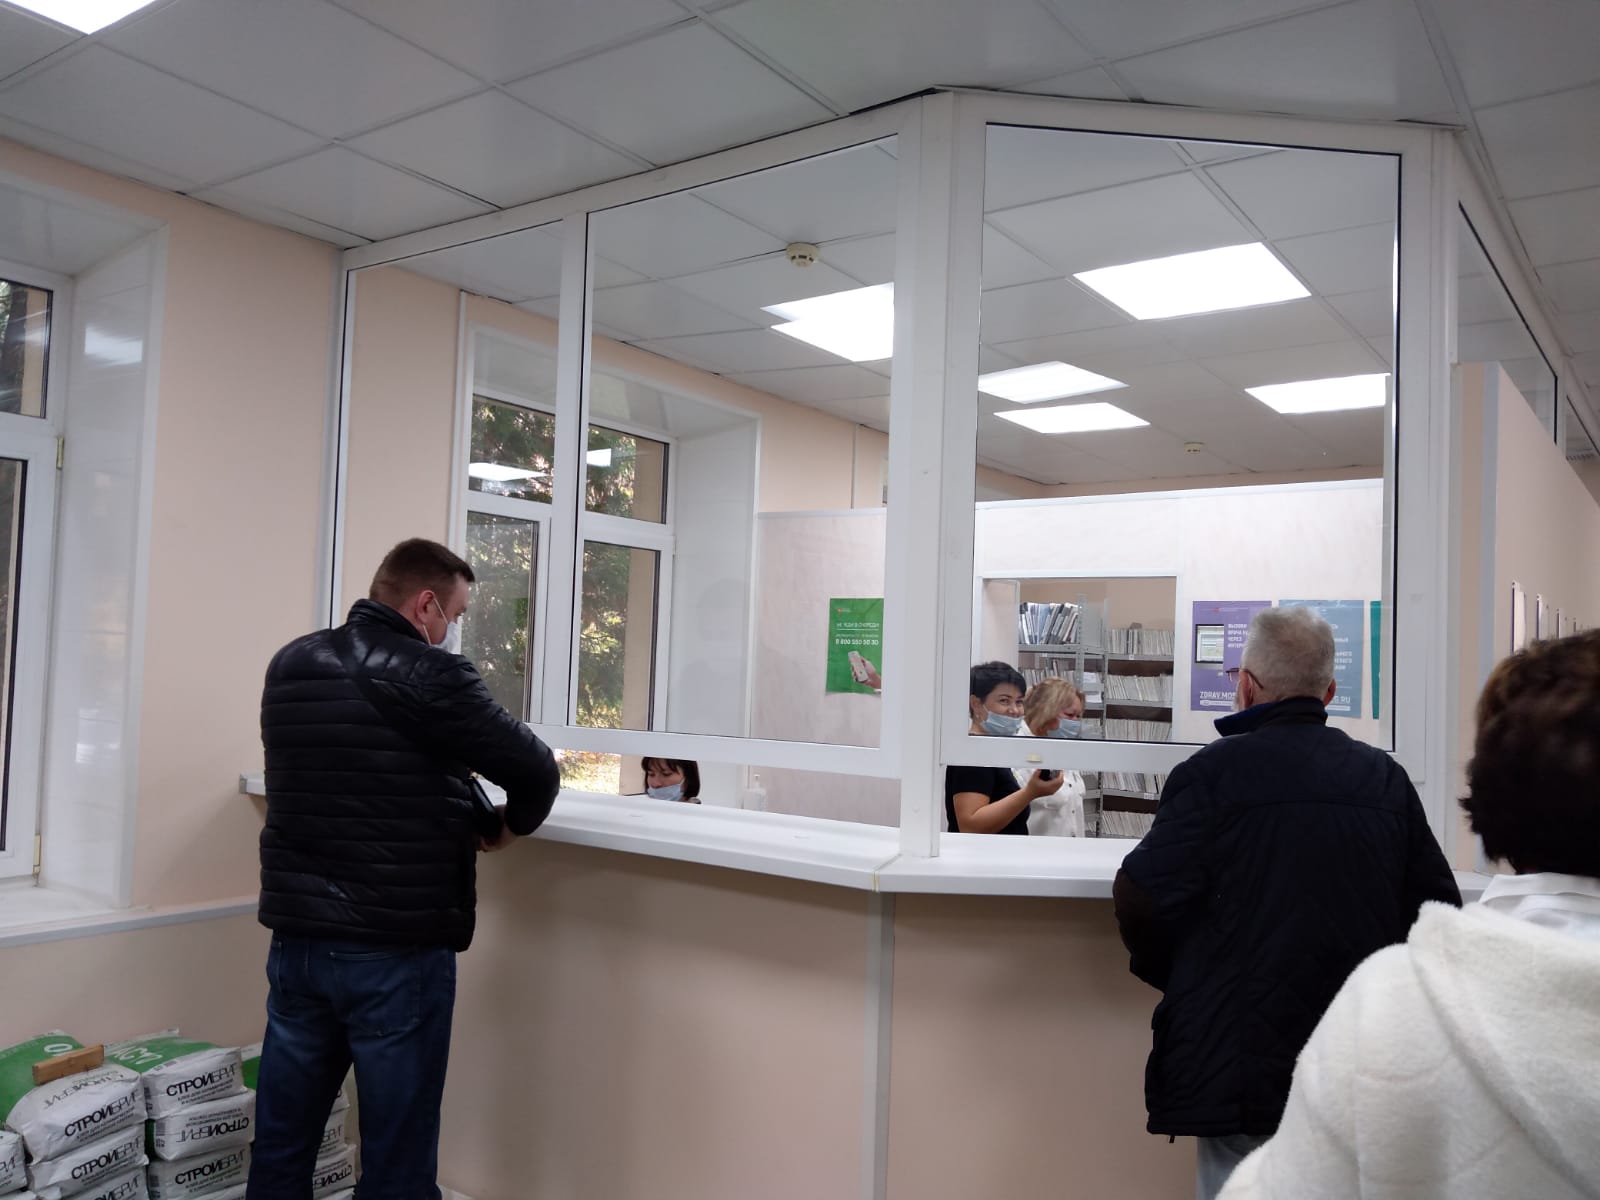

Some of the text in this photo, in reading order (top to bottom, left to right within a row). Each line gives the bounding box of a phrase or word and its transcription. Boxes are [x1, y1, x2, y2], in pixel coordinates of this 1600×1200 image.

[1199, 691, 1237, 700] ZDRAV.MOS
[166, 1063, 238, 1097] СТРОЙБРИГ
[64, 1088, 140, 1137] СТРОЙБРИГ
[176, 1117, 249, 1143] СТРОЙБРИГ
[71, 1136, 141, 1180] СТРОЙБРИГ
[174, 1149, 246, 1185] СТРОЙБРИГ
